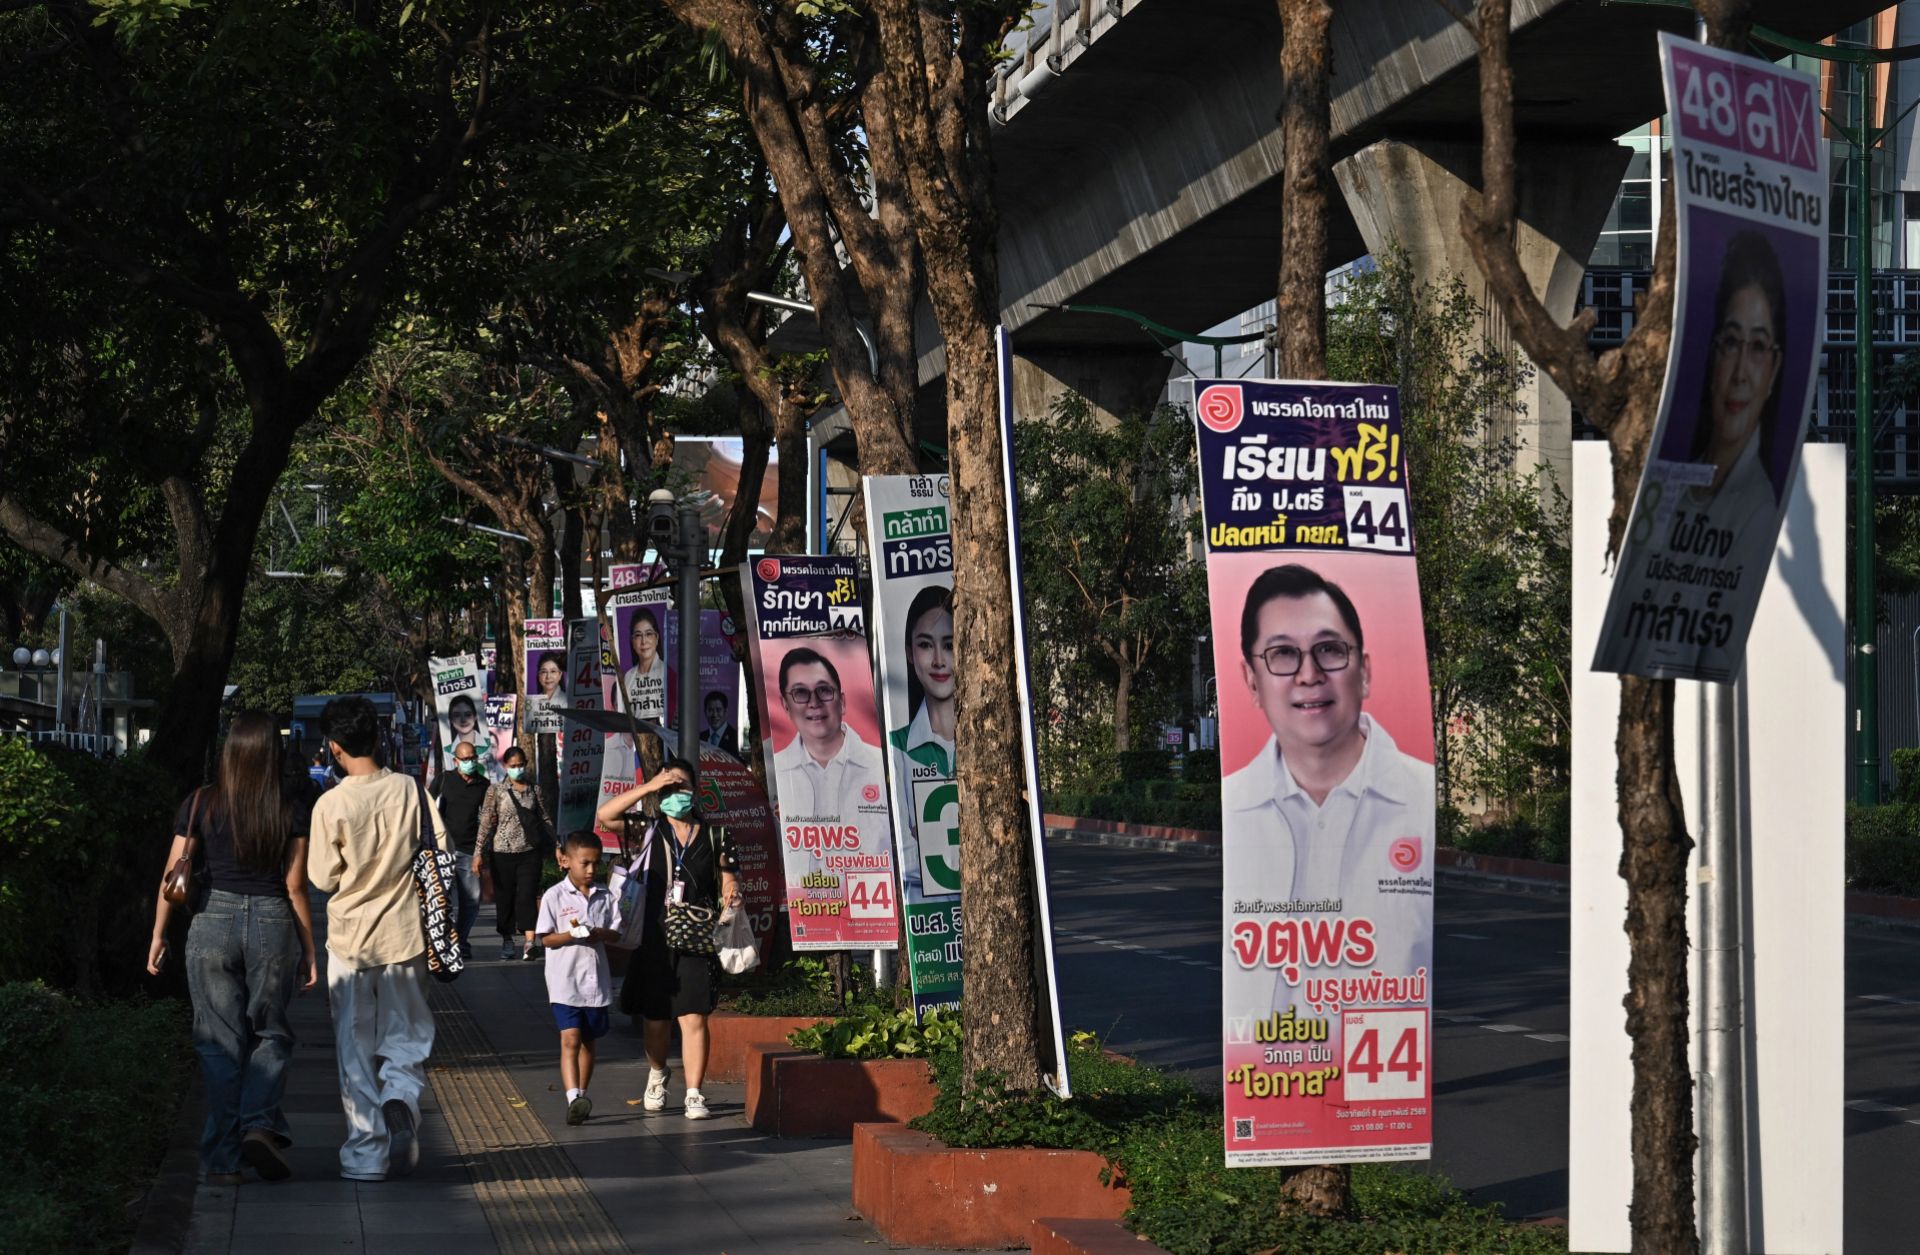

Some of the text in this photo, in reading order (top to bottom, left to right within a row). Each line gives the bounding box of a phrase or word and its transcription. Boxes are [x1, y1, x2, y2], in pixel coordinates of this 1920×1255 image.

[1681, 66, 1738, 138] 48
[1681, 150, 1821, 227] ไทยสร้างไทย
[1252, 395, 1390, 420] พรรคโอกาสใหม่
[910, 489, 934, 498] ธรรม
[1231, 486, 1325, 512] ถึง ป.ตรี
[887, 509, 944, 536] กล้าทำ
[1209, 513, 1345, 547] ปลดหนี้ กยศ.
[1350, 500, 1406, 547] 44
[1668, 511, 1734, 559] ไม่โกง
[782, 562, 854, 576] พรรคโอกาสใหม่
[890, 539, 952, 574] ทำจริ
[1645, 554, 1743, 591] มีประสบการณ์
[762, 611, 828, 638] ทุกที่มีหมอ
[1622, 588, 1734, 648] ทำสำเร็จ
[440, 677, 474, 694] ทำจริง
[912, 763, 937, 778] เบอร์
[786, 825, 860, 857] จตุพร
[825, 851, 890, 873] บุรุษพัฒน์
[801, 869, 839, 888] เปลี่ยน
[851, 881, 892, 910] 44
[1232, 917, 1376, 986] จตุพร
[916, 970, 945, 989] ผู้สมัคร
[1305, 967, 1427, 1013] บุรุษพัฒน์
[1254, 1005, 1327, 1042] เปลี่ยน
[1264, 1044, 1332, 1066] วิกฤต เป็น
[1347, 1027, 1422, 1084] 44
